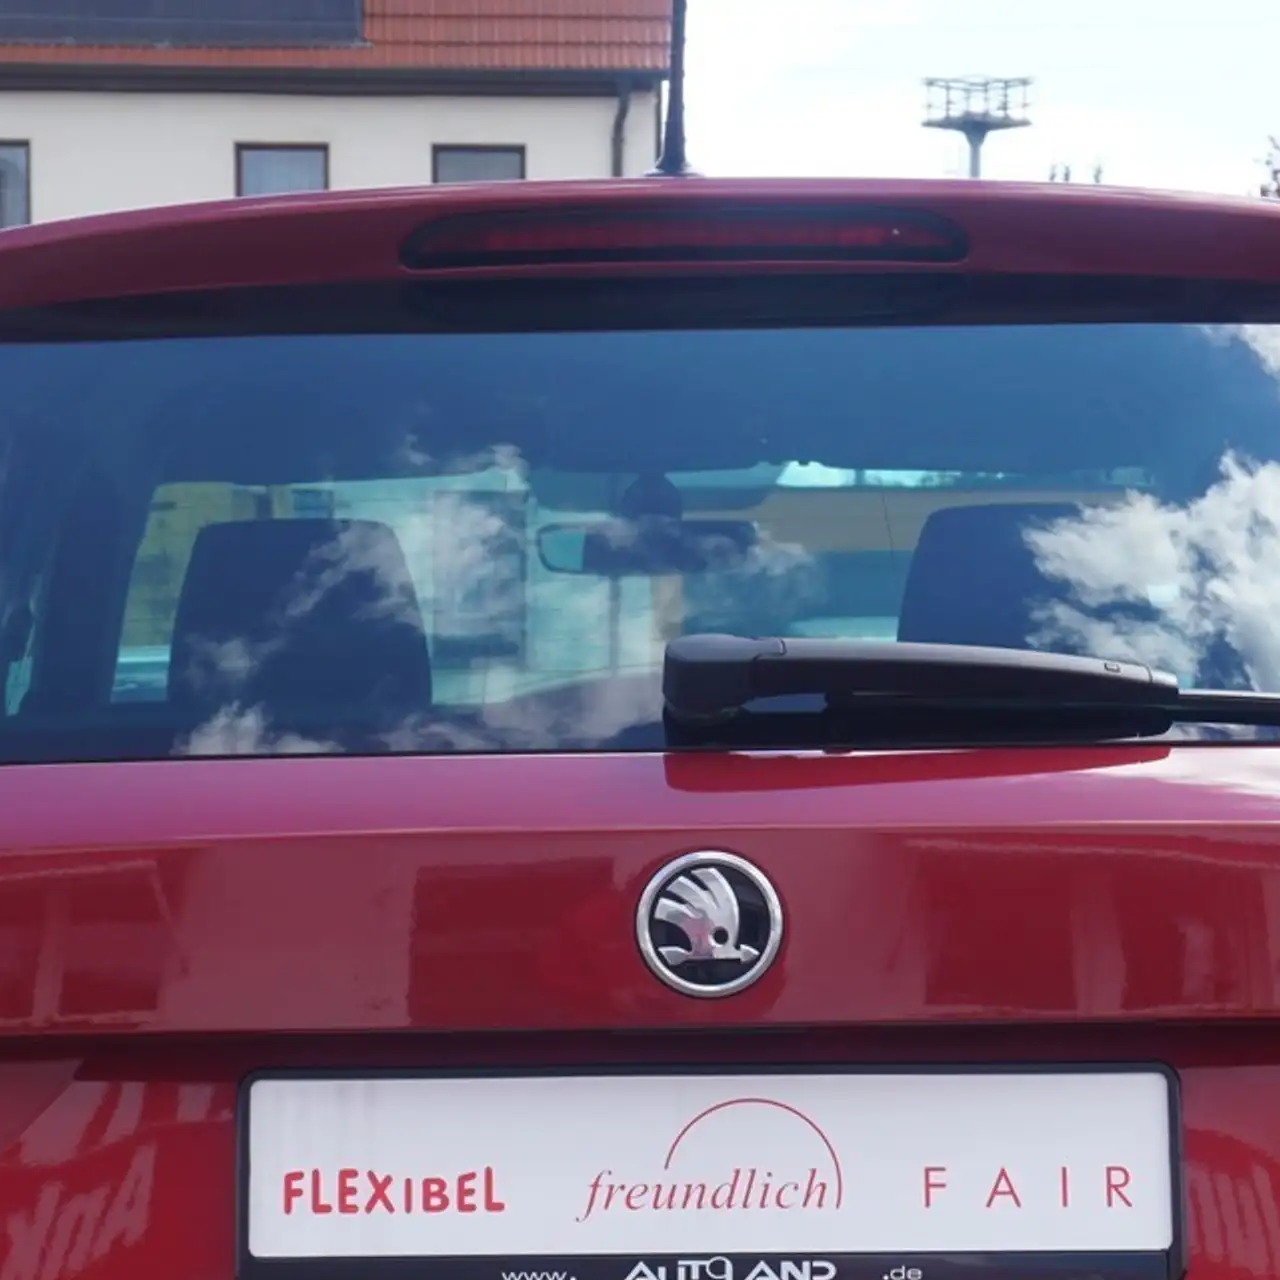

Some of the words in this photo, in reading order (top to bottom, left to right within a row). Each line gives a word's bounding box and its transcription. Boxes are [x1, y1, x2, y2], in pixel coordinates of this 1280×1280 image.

[283, 1165, 505, 1216] FLEXIBEL
[574, 1167, 828, 1223] freundlich
[923, 1165, 1133, 1208] FAIR
